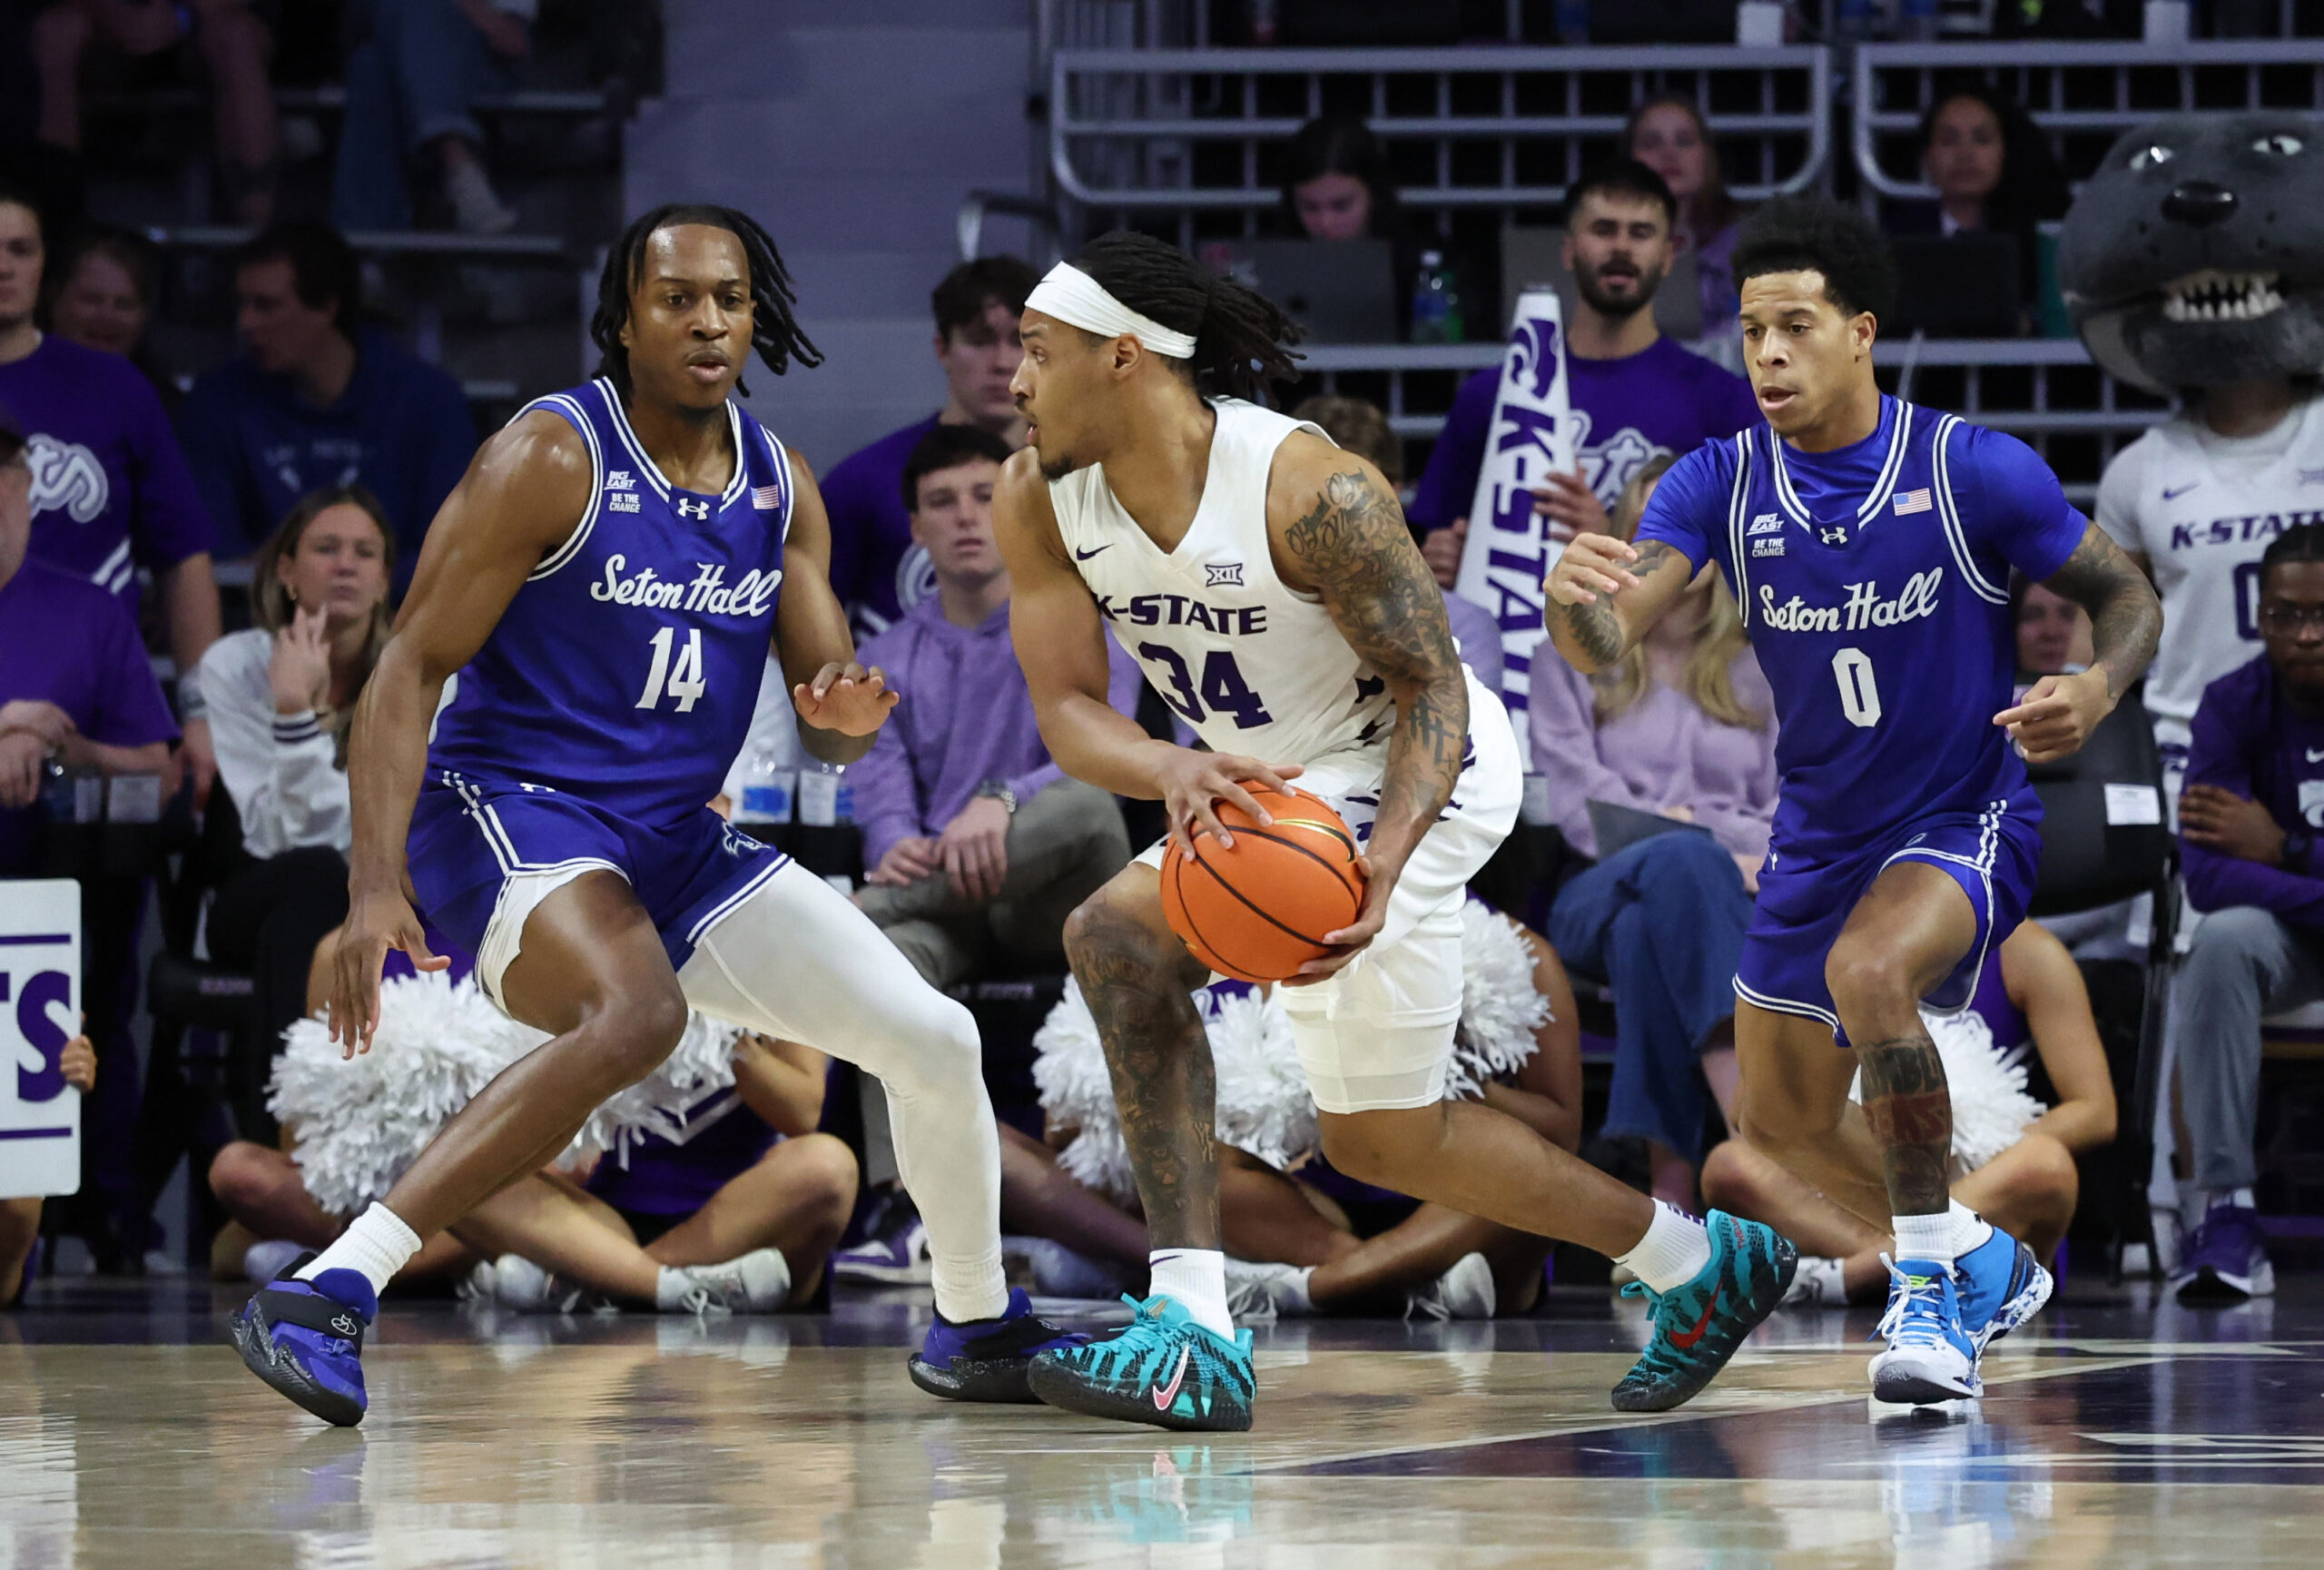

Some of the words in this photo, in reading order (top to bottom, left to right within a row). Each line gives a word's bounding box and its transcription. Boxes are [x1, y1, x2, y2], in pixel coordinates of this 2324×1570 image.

[609, 470, 630, 480] BIG
[606, 479, 637, 489] EAST
[611, 492, 623, 503] BE
[624, 493, 640, 504] THE
[609, 501, 641, 514] CHANGE
[1753, 513, 1778, 524] BIG
[1748, 520, 1786, 532] EAST
[2171, 510, 2324, 550] K-STA
[1754, 538, 1768, 549] BE
[1768, 538, 1786, 548] THE
[1752, 547, 1786, 558] CHANGE
[591, 554, 684, 609] Seton
[684, 562, 783, 617] Hall
[1759, 584, 1842, 632] Seton
[1843, 567, 1944, 632] Hall
[635, 627, 706, 713] 14
[1137, 641, 1274, 730] 34
[1831, 647, 1882, 727] 0
